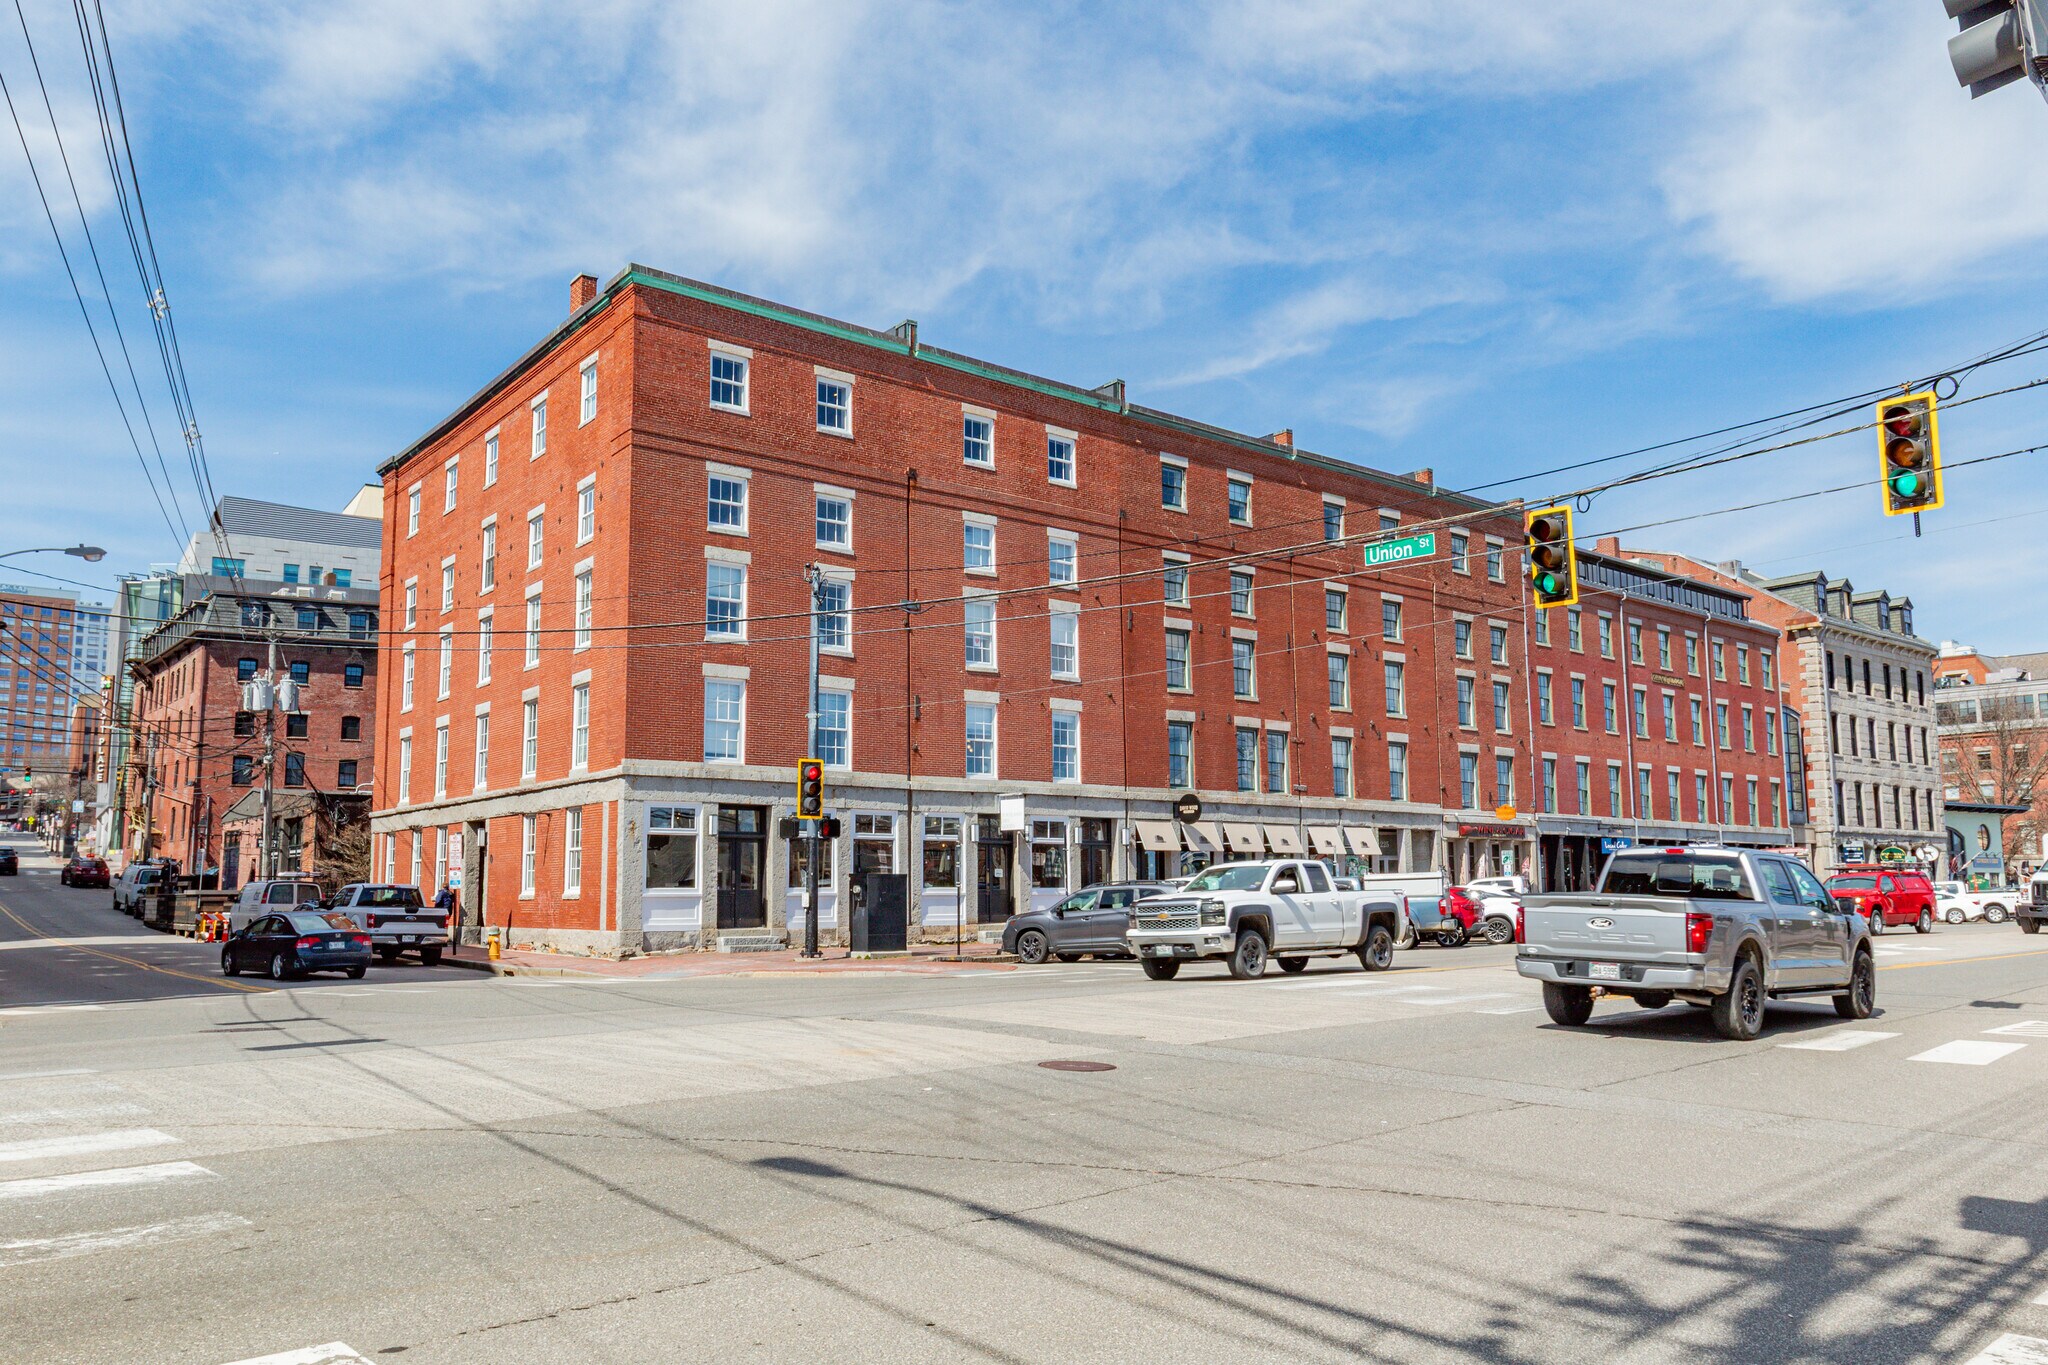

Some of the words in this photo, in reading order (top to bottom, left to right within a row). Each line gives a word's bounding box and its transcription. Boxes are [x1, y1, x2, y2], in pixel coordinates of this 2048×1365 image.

[1369, 544, 1412, 563] Union
[1419, 538, 1429, 548] St
[96, 737, 106, 782] PLACE
[1551, 930, 1656, 945] F-150
